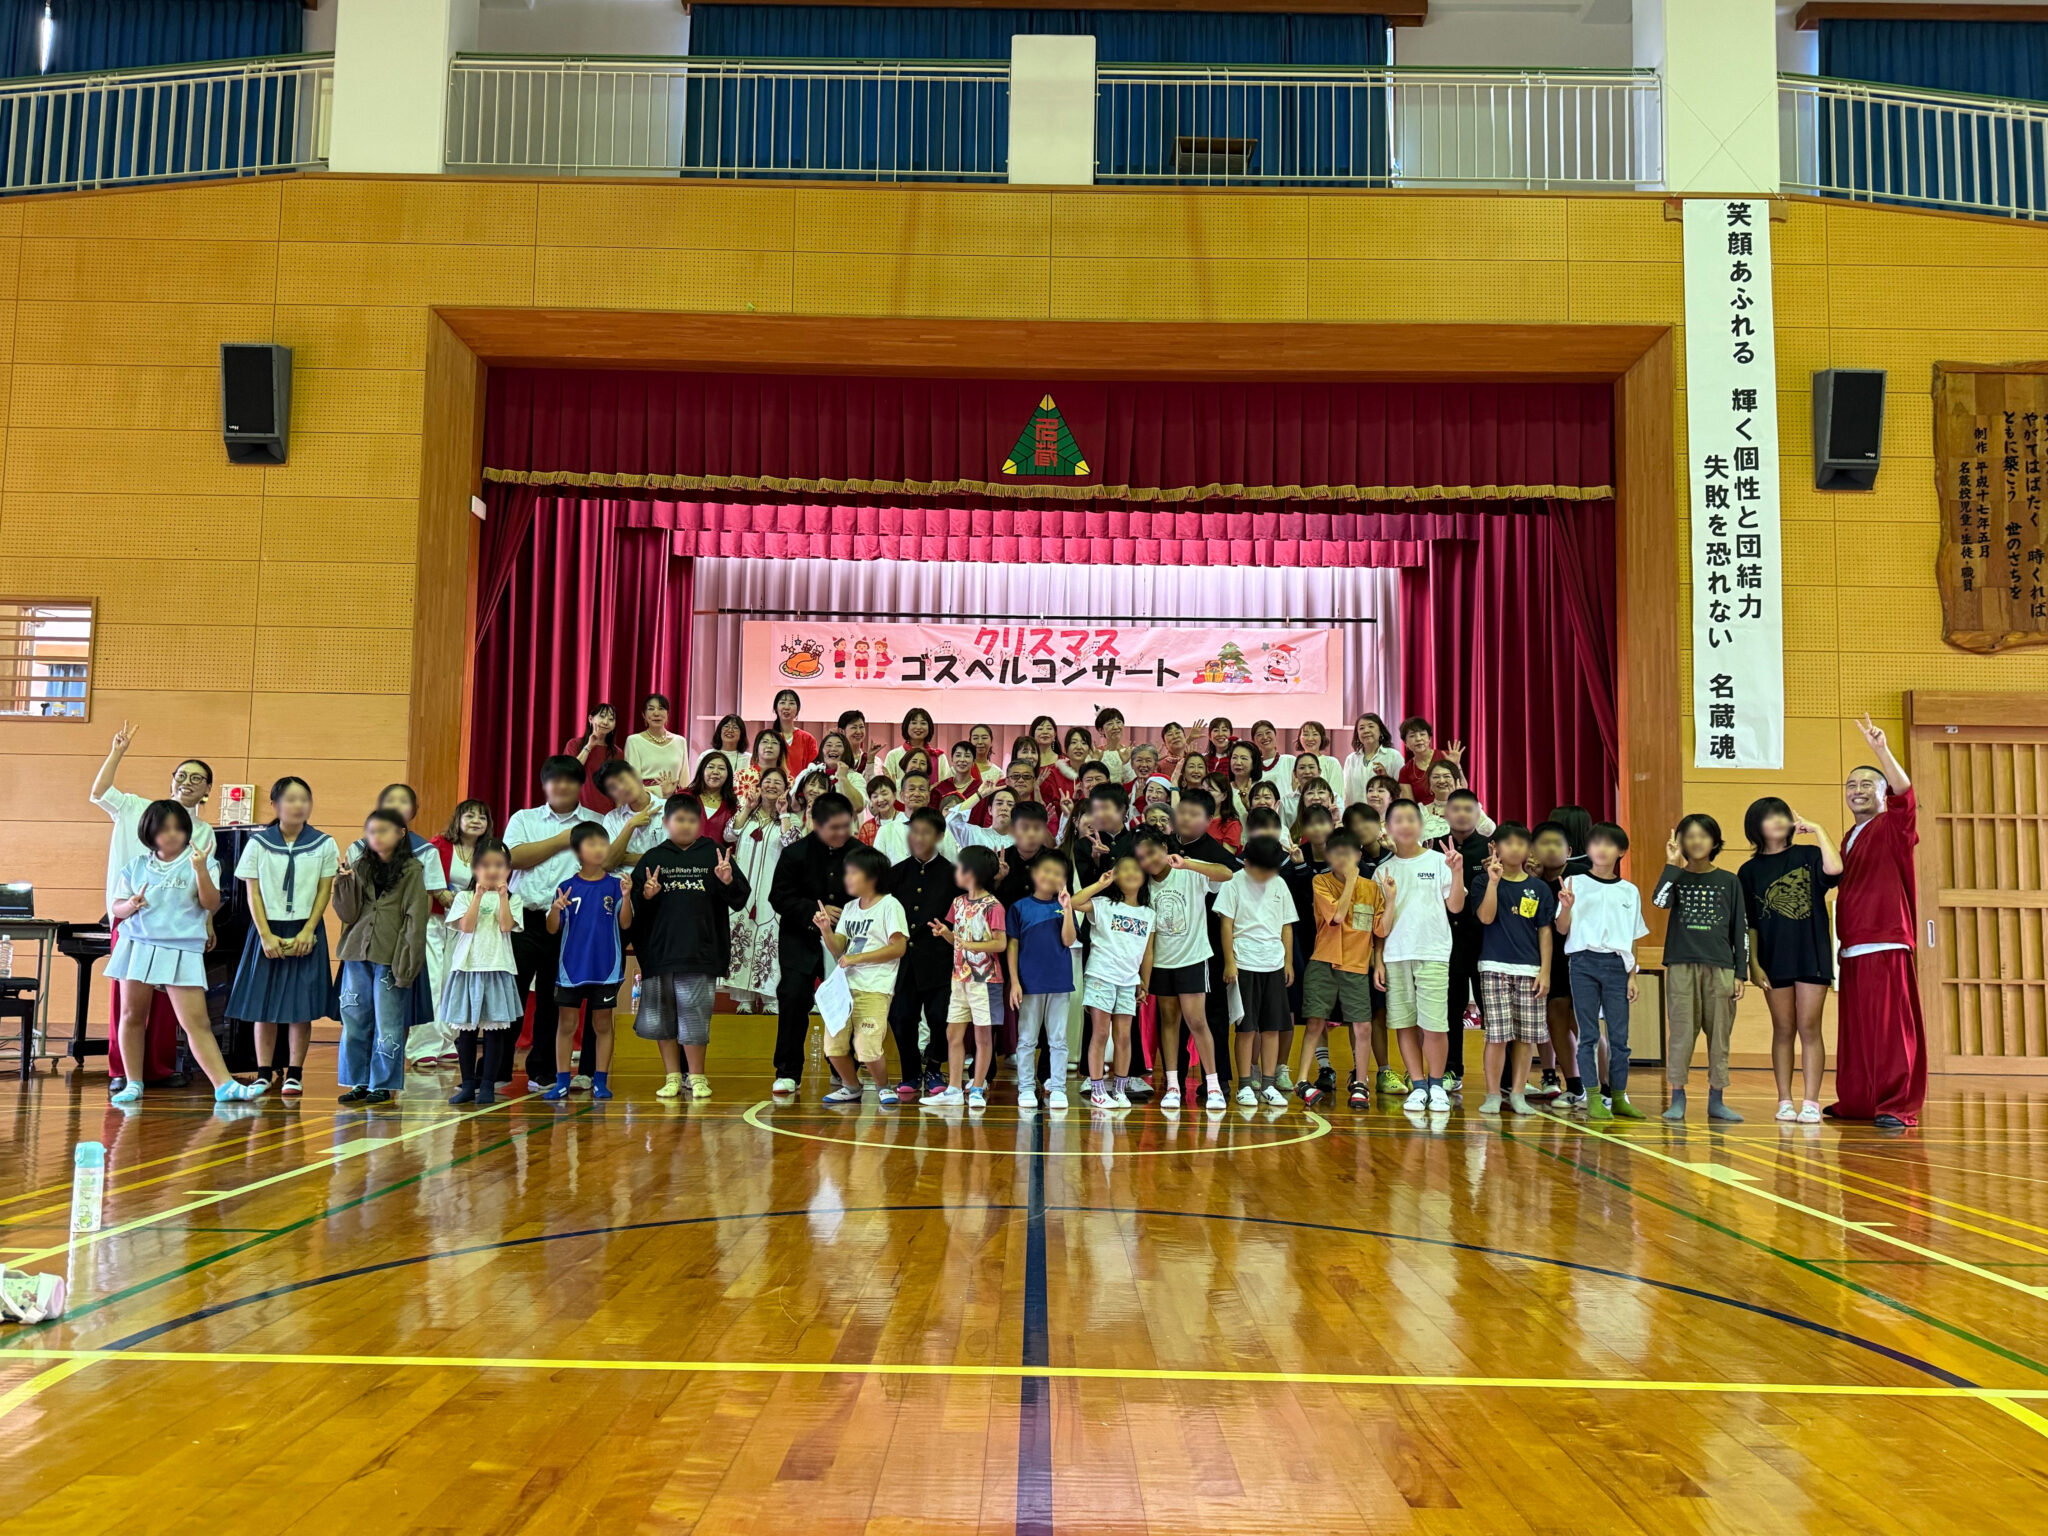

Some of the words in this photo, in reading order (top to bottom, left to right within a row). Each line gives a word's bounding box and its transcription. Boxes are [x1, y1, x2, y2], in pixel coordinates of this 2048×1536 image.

[1727, 202, 1754, 364] 笑顔あふれる
[2003, 411, 2019, 503] ともに築こう
[2023, 412, 2041, 527] やがてはばたく
[1732, 388, 1761, 619] 輝く個性と団結力
[1975, 462, 1991, 558] 平成十七年五月
[1704, 455, 1732, 648] 失敗を恐れない
[2005, 521, 2022, 600] 世のさちを
[2028, 548, 2047, 618] 時くれば
[901, 654, 1180, 687] ゴスペルコンサート
[974, 626, 1120, 657] クリスマス
[1709, 673, 1736, 760] 名蔵魂
[571, 896, 582, 915] 7
[1113, 918, 1147, 934] ROXY
